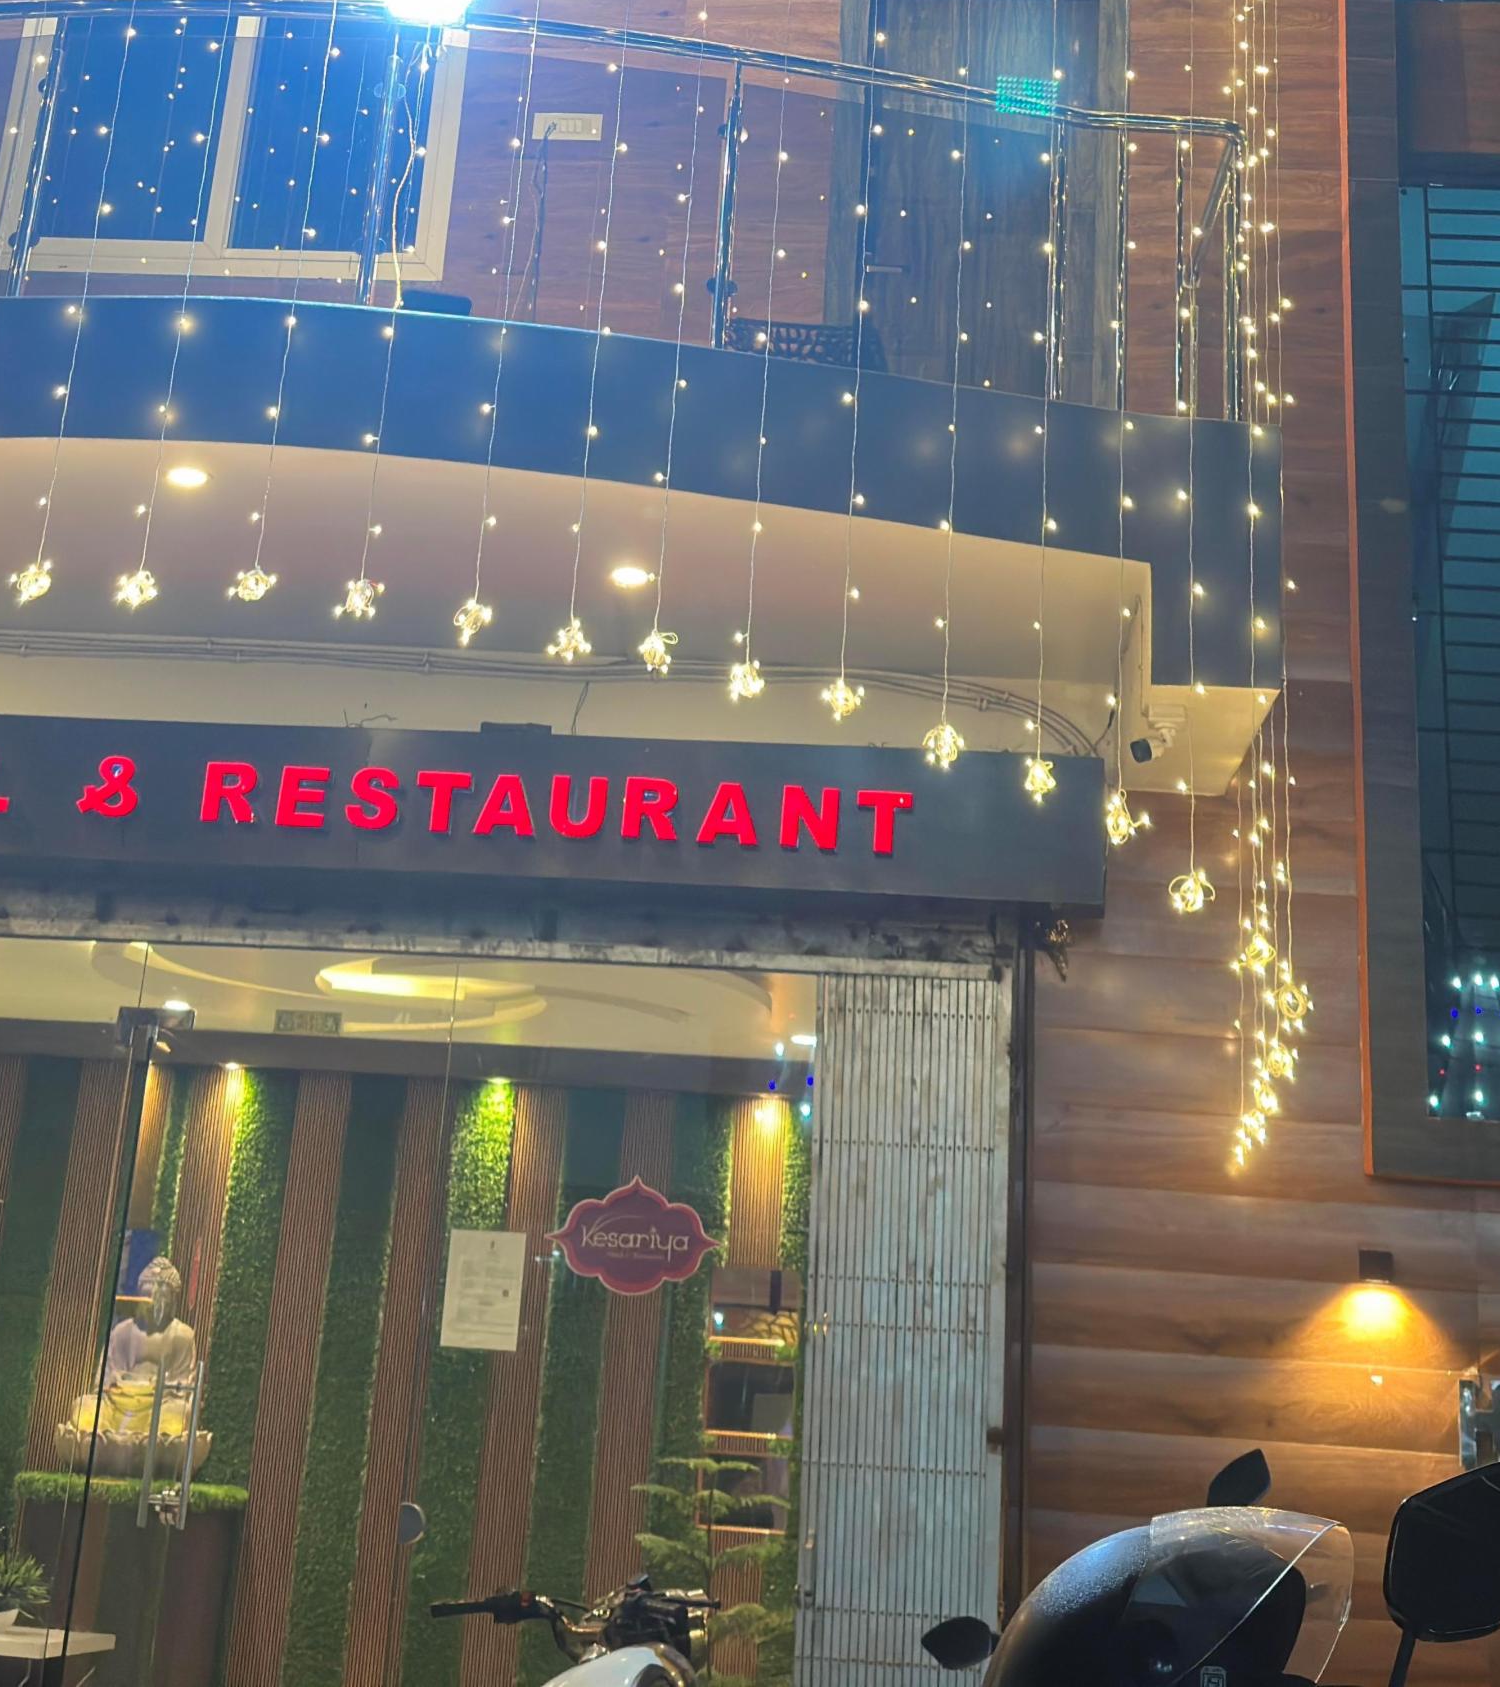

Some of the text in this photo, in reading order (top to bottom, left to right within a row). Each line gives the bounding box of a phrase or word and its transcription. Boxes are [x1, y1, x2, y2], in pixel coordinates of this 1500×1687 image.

[76, 756, 140, 819] &
[201, 762, 915, 855] RESTAURANT
[580, 1220, 691, 1263] Kesariya
